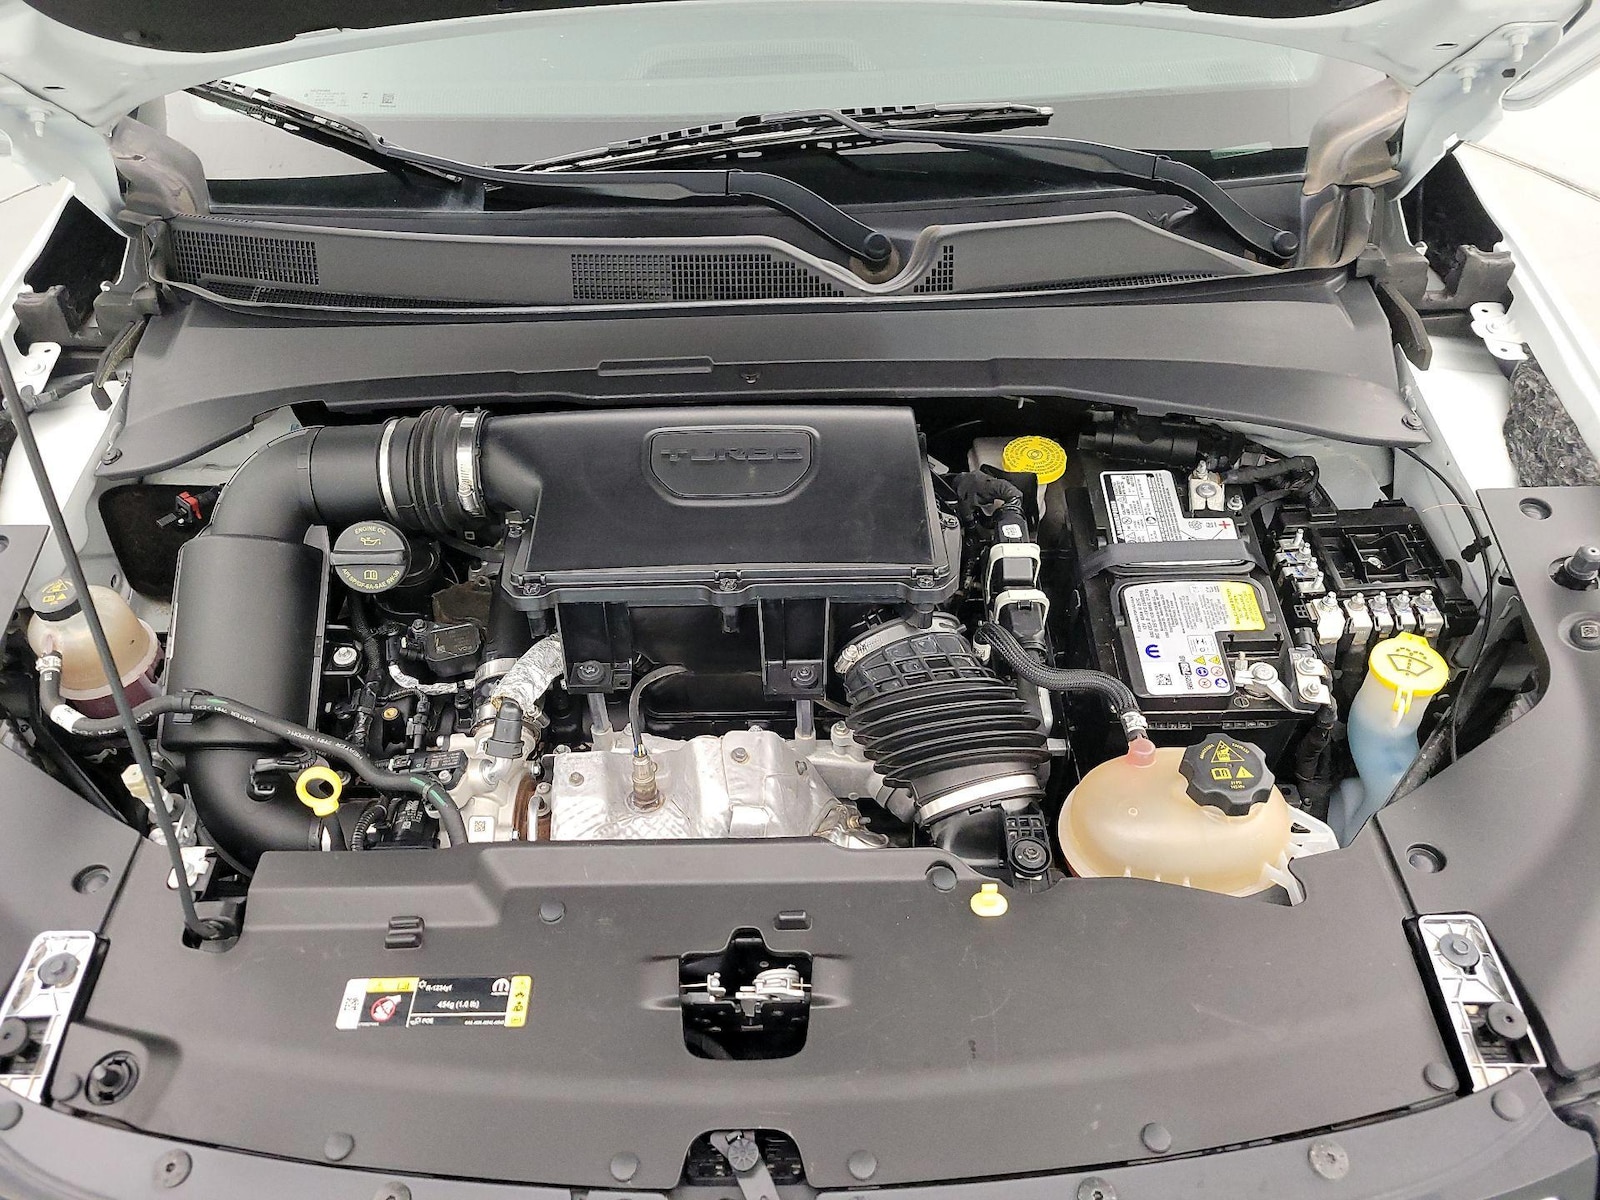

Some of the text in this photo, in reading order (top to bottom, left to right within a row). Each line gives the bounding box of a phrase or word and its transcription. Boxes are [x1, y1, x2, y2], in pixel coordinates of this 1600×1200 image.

[660, 447, 804, 462] TURBO
[354, 525, 388, 536] ENGINE OIL
[341, 568, 351, 578] API
[230, 710, 257, 725] HEATER
[335, 741, 363, 761] HEATER
[436, 1000, 480, 1010] 454g (1.0 lb)
